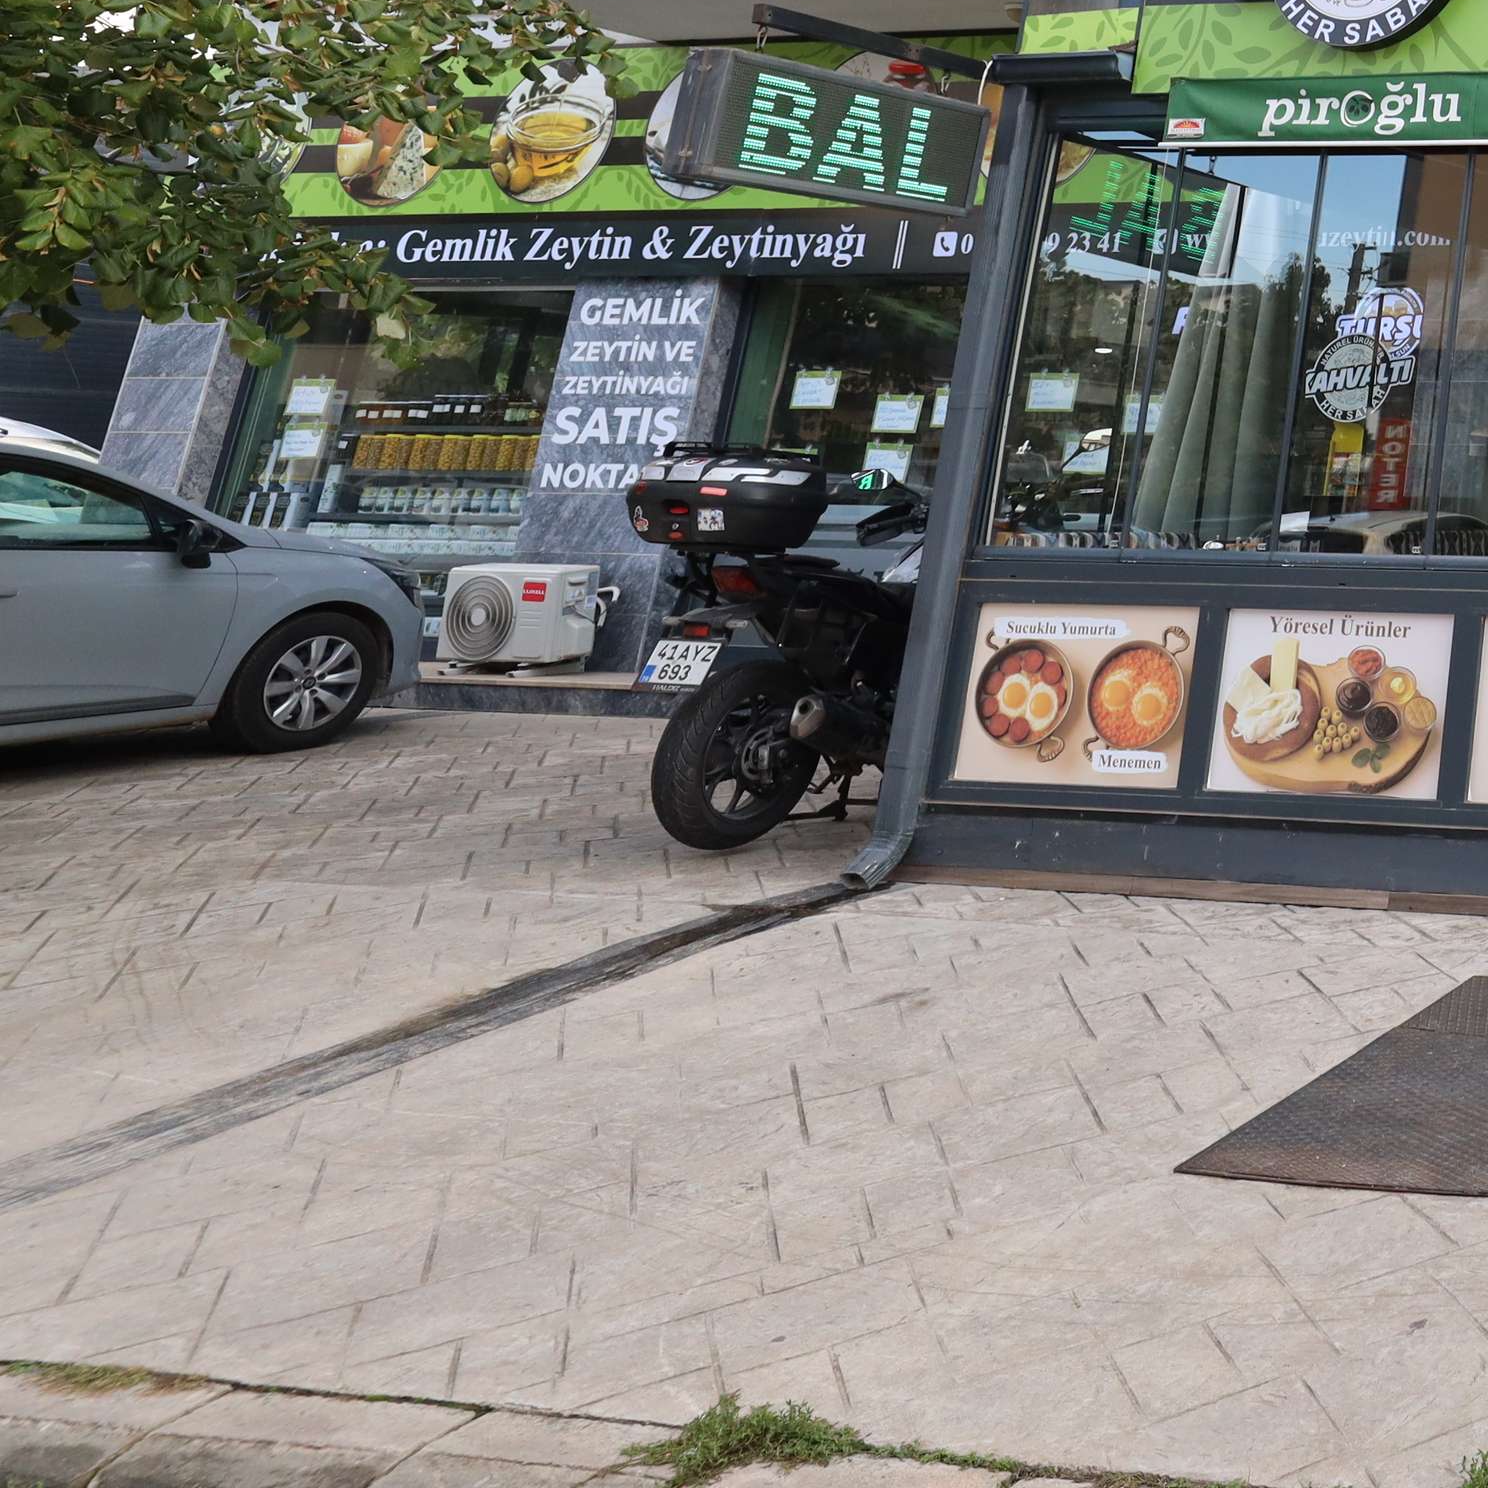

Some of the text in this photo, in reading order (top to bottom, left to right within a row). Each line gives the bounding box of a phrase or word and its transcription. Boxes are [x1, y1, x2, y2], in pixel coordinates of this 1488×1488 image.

[1258, 83, 1461, 137] piroğlu
[738, 72, 948, 202] BAL
[396, 228, 518, 264] Gemlik
[523, 226, 631, 270] Zeytin
[642, 230, 673, 261] &
[683, 223, 867, 268] Zeytinyağı
[580, 289, 705, 325] GEMLİK
[569, 334, 697, 362] ZEYTİN VE
[562, 370, 690, 394] ZEYTİNYAĞI
[1320, 401, 1343, 421] HER
[551, 407, 681, 457] SATIŞ
[540, 463, 639, 489] NOKTA
[1006, 621, 1117, 636] Sucuklu Yumurta
[1270, 614, 1411, 638] Yöresel Ürünler
[657, 663, 692, 681] 693
[1098, 754, 1161, 769] Menemen
